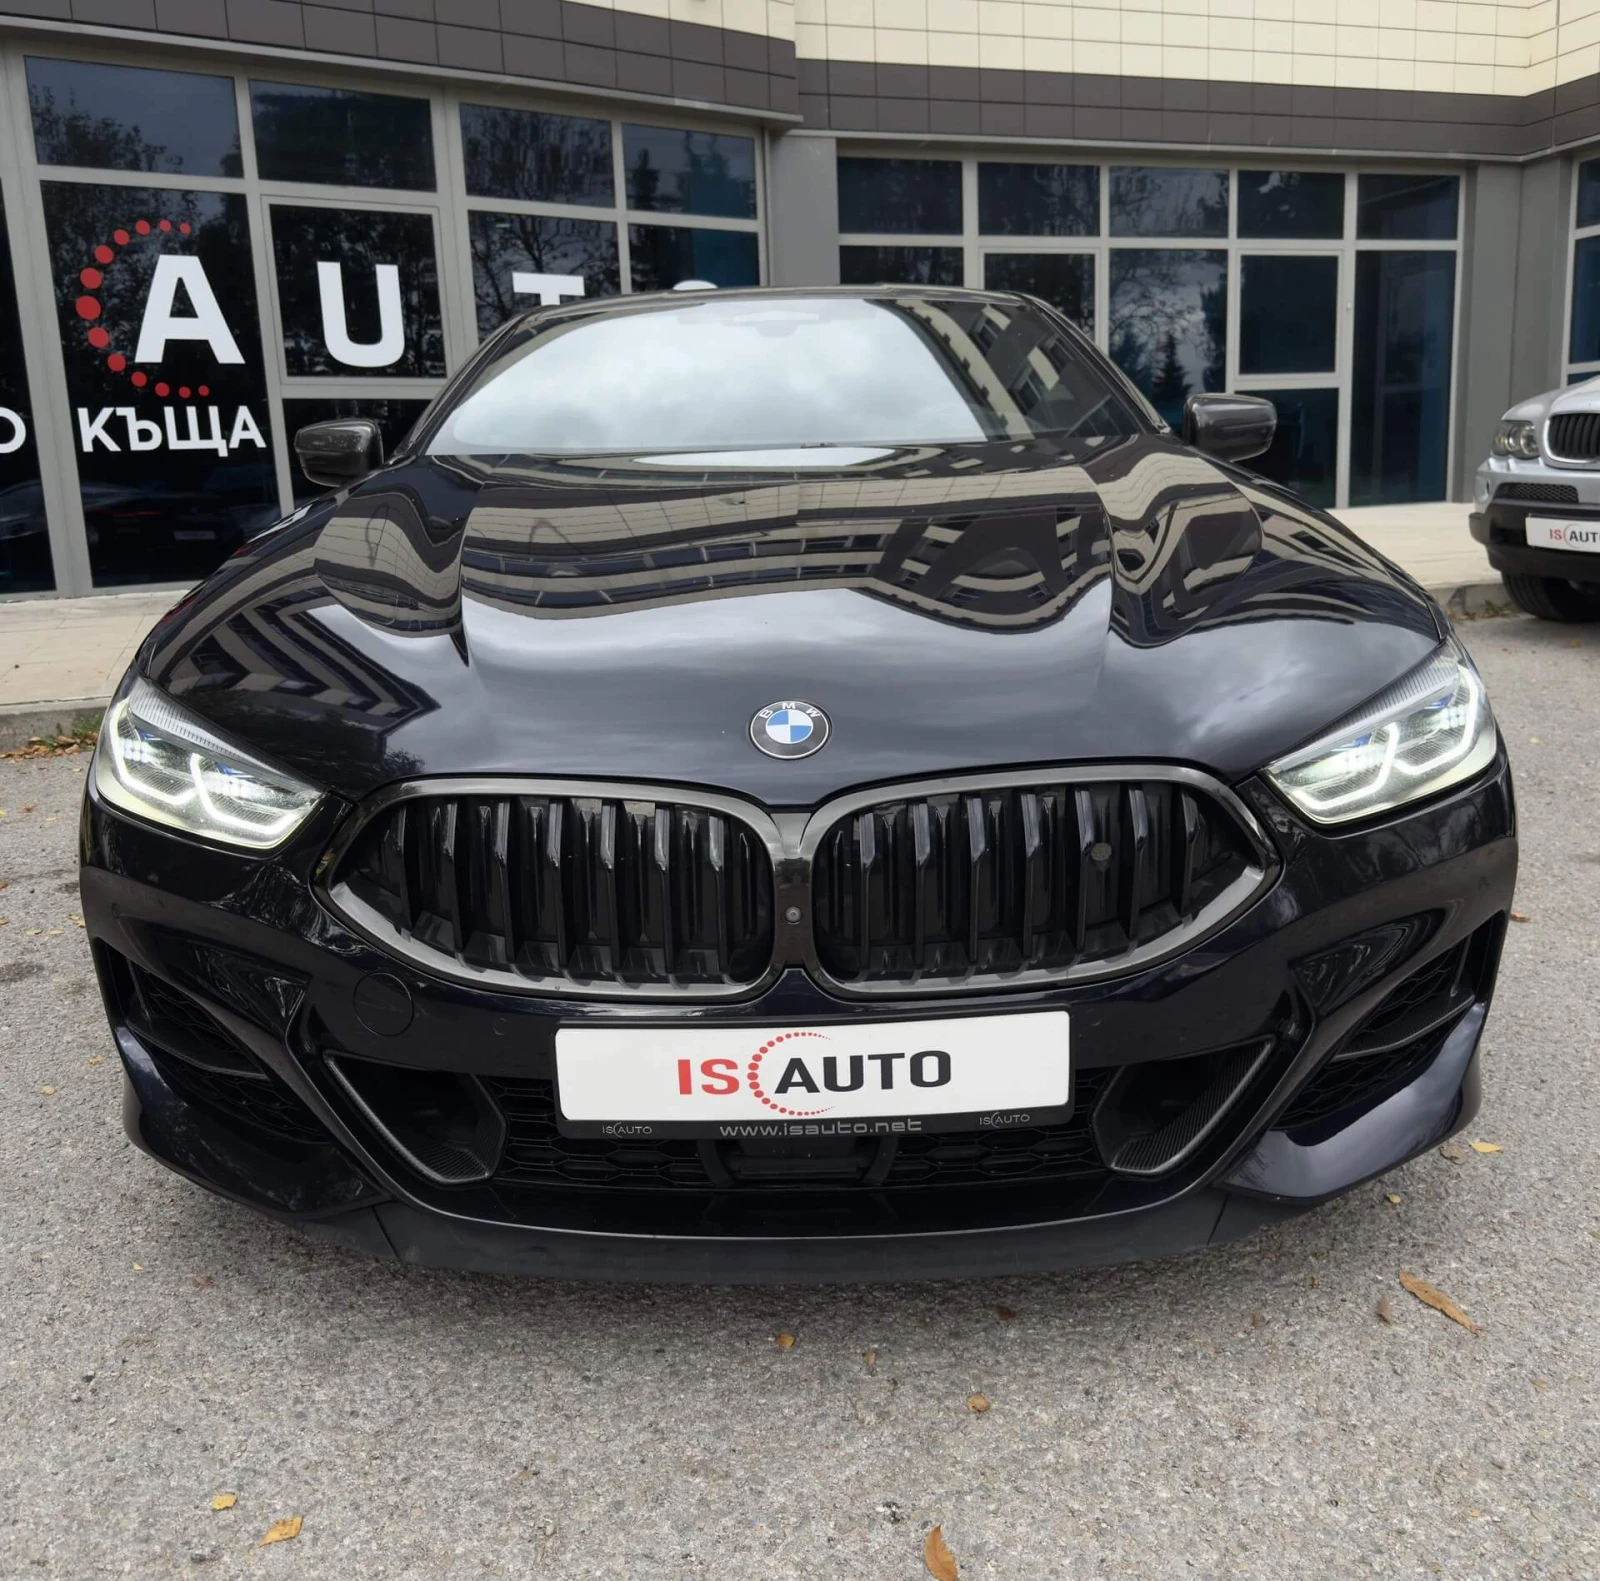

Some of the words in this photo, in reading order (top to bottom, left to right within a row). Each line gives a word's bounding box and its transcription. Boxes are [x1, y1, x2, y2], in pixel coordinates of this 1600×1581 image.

[135, 254, 718, 367] AUT
[77, 405, 267, 457] КЪЩА
[1569, 530, 1600, 543] AUT
[759, 702, 820, 719] BMW
[677, 1058, 739, 1095] IS
[774, 1050, 952, 1094] AUTO
[719, 1118, 922, 1137] www.isauto.net
